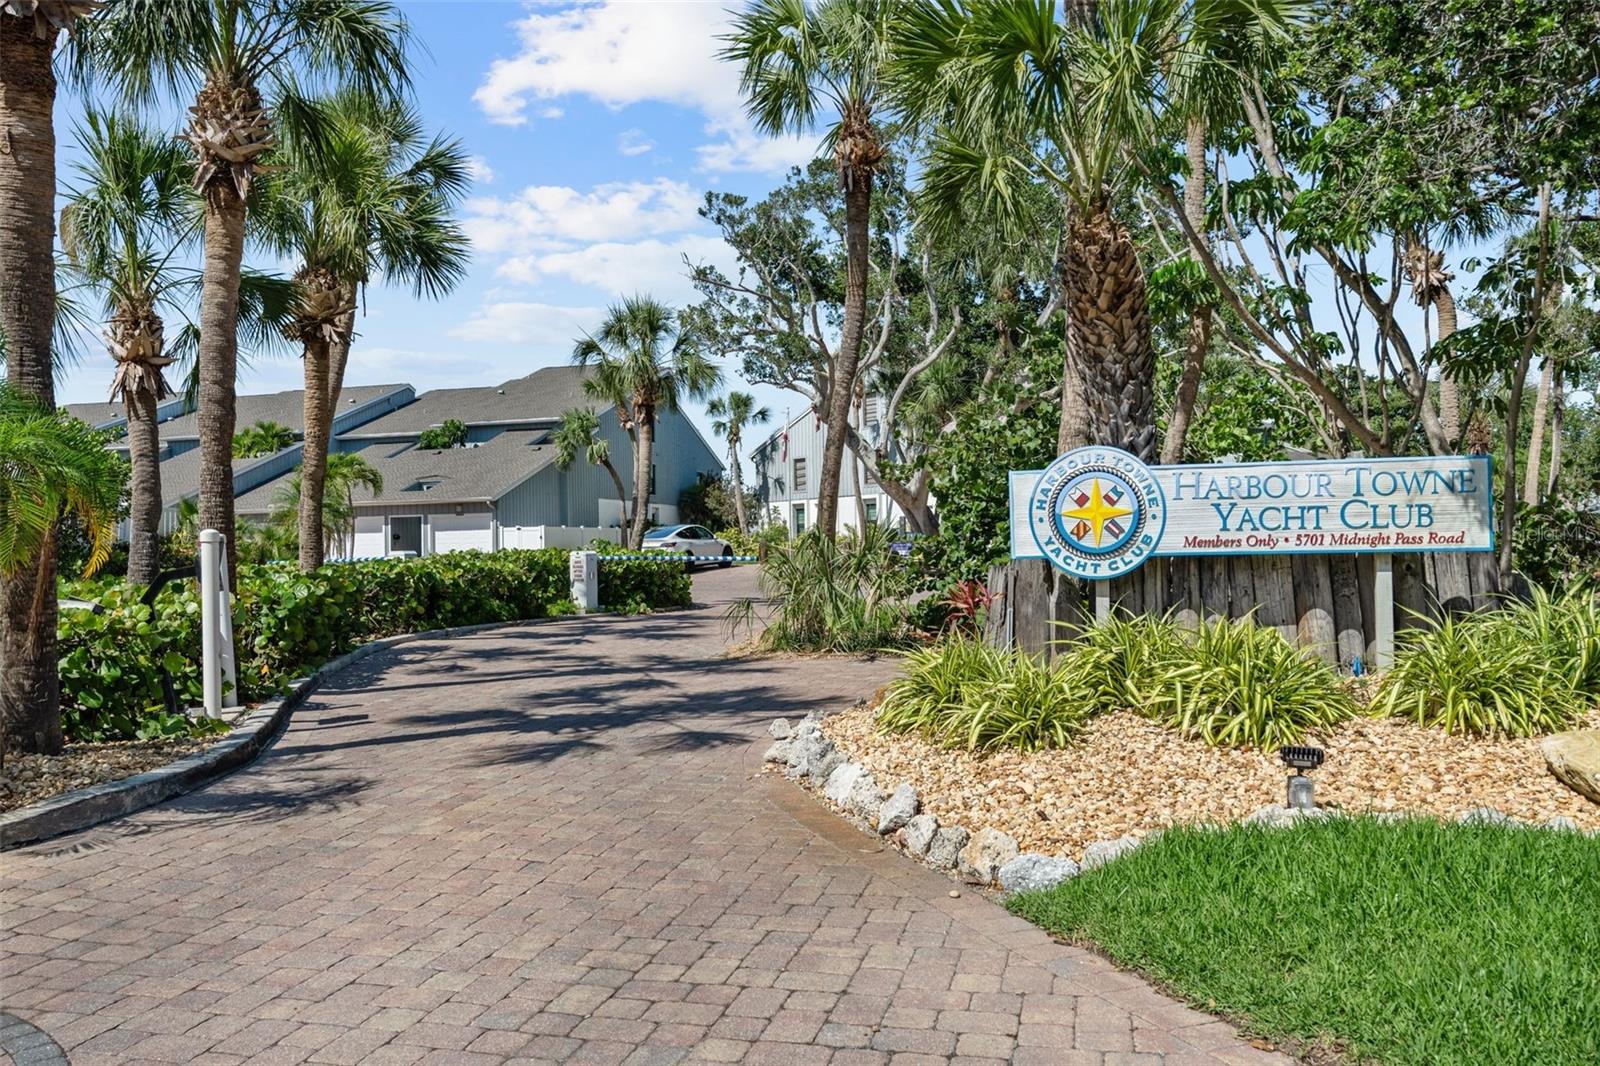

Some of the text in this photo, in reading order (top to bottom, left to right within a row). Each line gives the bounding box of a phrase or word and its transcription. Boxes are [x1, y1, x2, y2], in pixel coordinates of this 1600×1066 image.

[1036, 453, 1160, 511] HARBOUR TOWNE
[1172, 466, 1477, 501] HARBOUR TOWNE
[1211, 499, 1434, 532] YACHT CLUB
[1044, 533, 1153, 573] YACHT CLUB
[1183, 530, 1466, 550] Members Only 5701 Midnight Pass Road
